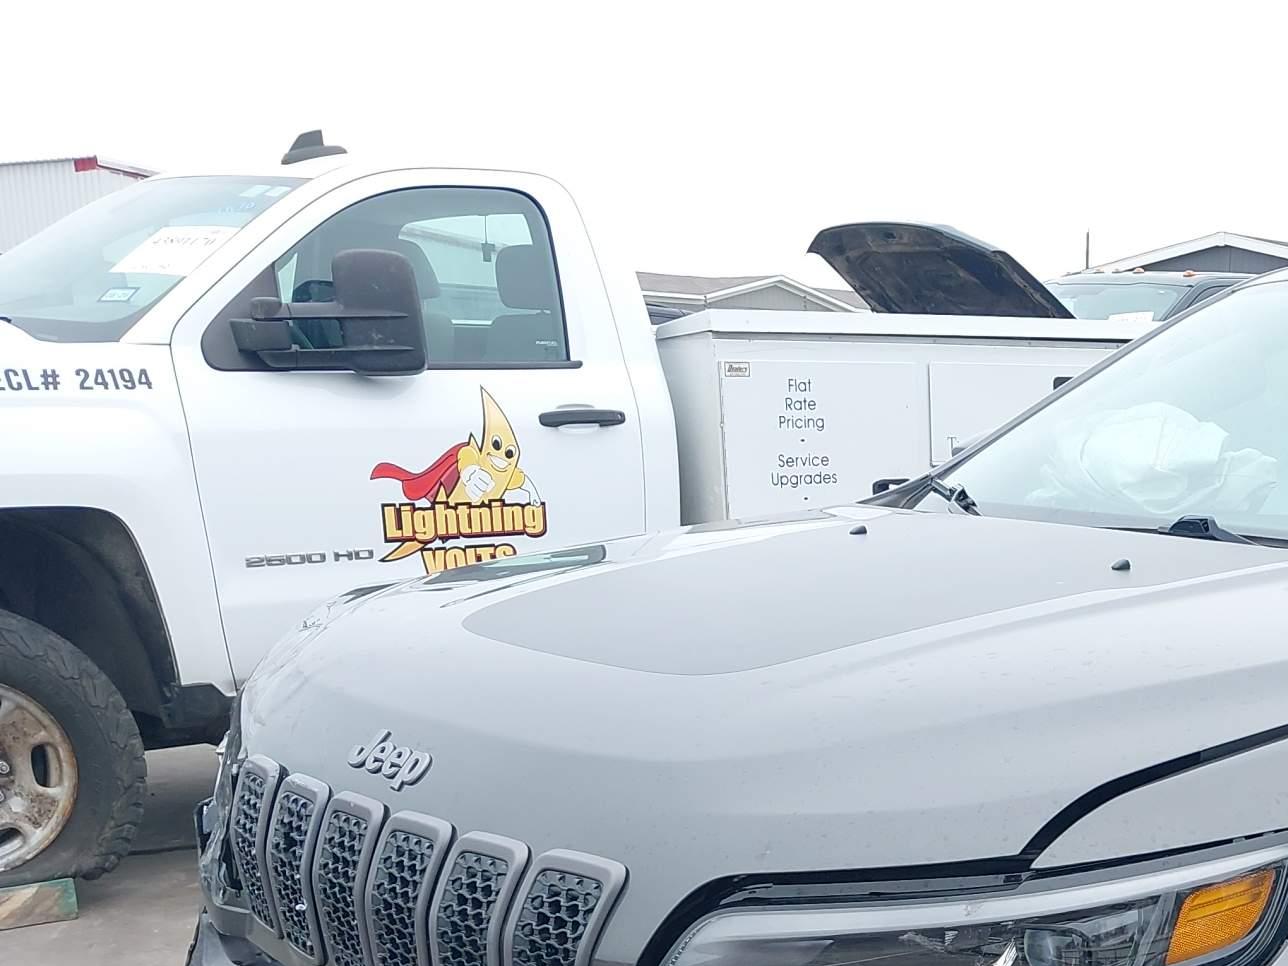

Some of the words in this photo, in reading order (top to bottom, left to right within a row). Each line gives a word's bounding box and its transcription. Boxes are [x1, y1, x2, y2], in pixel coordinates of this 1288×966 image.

[75, 368, 152, 390] 24194
[788, 378, 812, 392] Flat
[784, 397, 817, 411] Rate
[778, 415, 825, 432] Pricing
[778, 453, 830, 468] Service
[771, 471, 838, 488] Upgrades
[382, 501, 547, 543] Lightning
[245, 552, 326, 569] 2500
[334, 548, 374, 562] HD
[347, 728, 433, 792] Jeep
